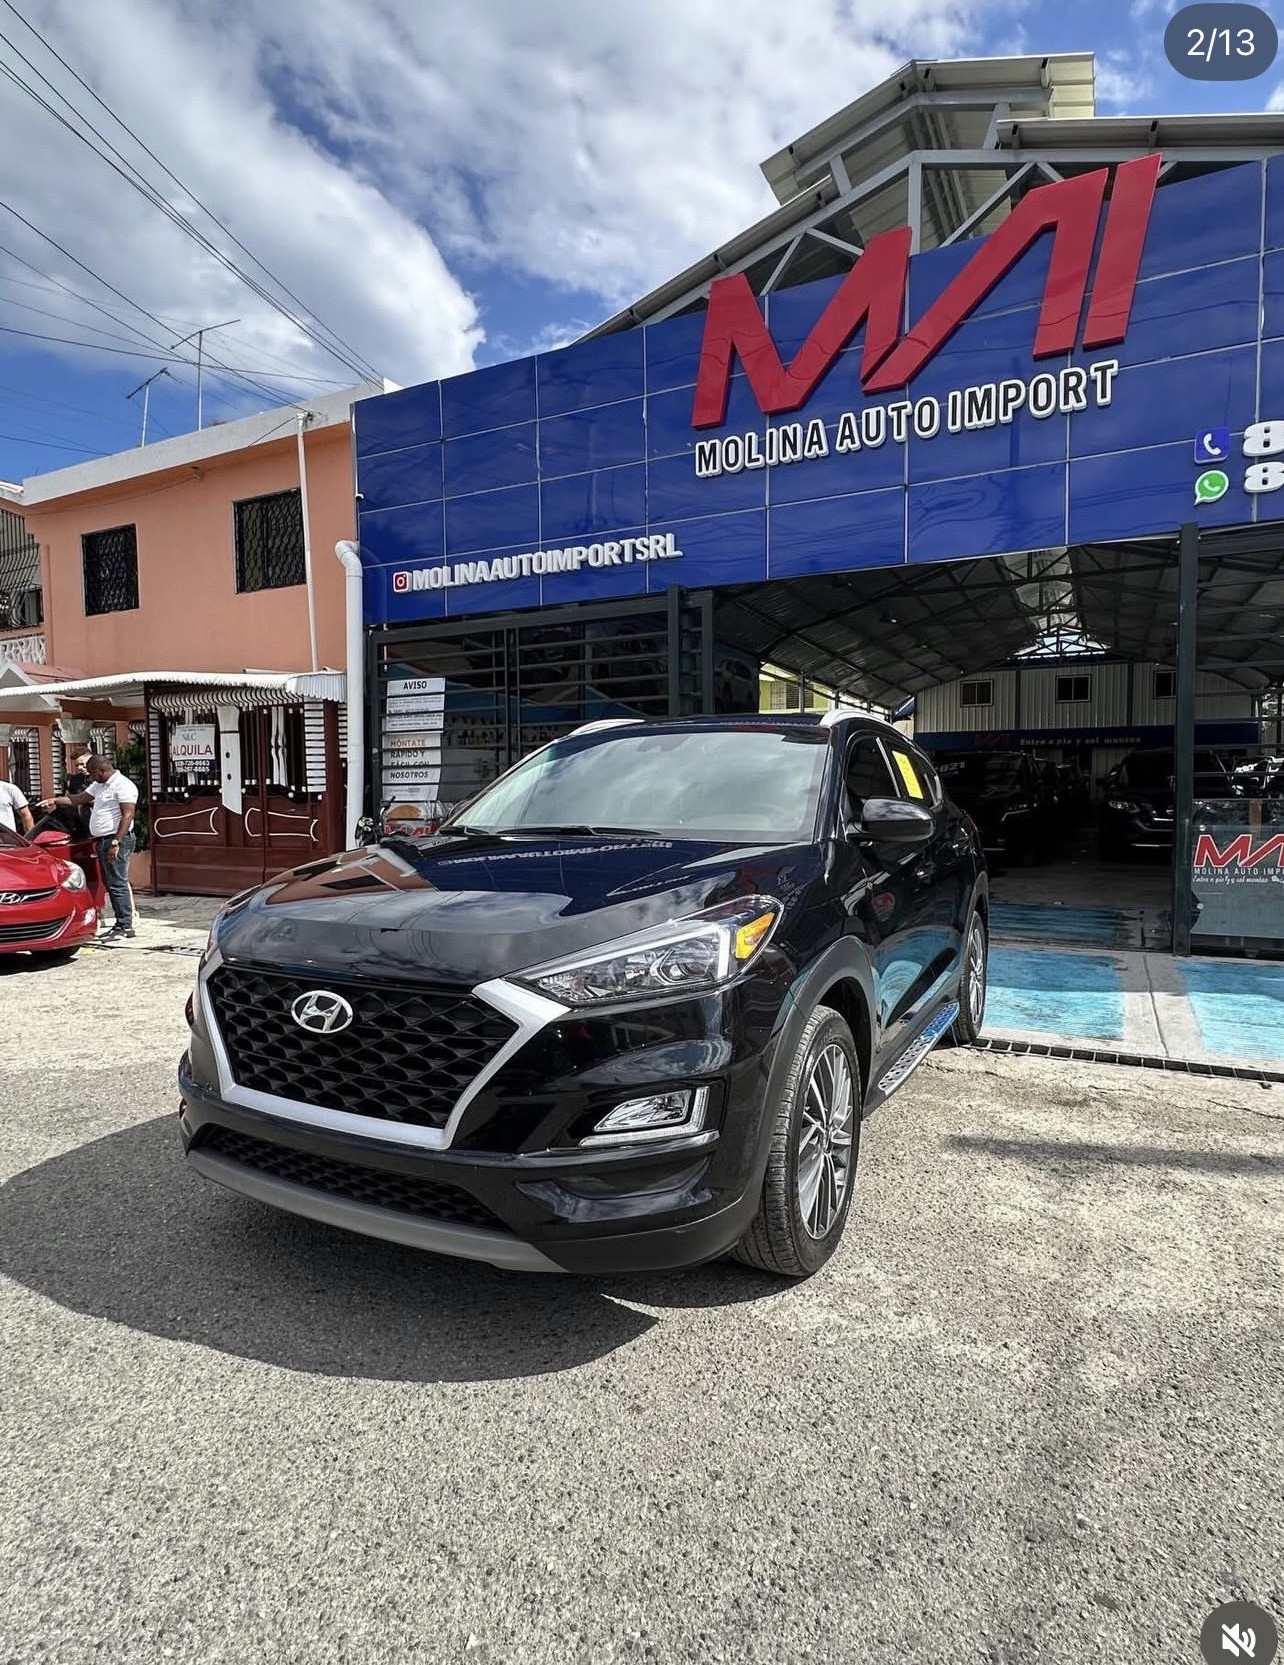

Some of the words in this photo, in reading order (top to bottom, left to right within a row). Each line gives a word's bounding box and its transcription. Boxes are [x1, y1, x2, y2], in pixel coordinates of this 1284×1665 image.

[691, 153, 1162, 429] MAI
[695, 418, 829, 478] MOLINA
[835, 398, 941, 454] AUTO
[947, 359, 1119, 434] IMPORT
[411, 533, 683, 591] MOLINAAUTOIMPORTSRL
[403, 680, 428, 690] AVISO
[390, 771, 429, 779] NOSOTROS
[1194, 867, 1230, 875] MOLINA
[1234, 867, 1259, 875] AUTO
